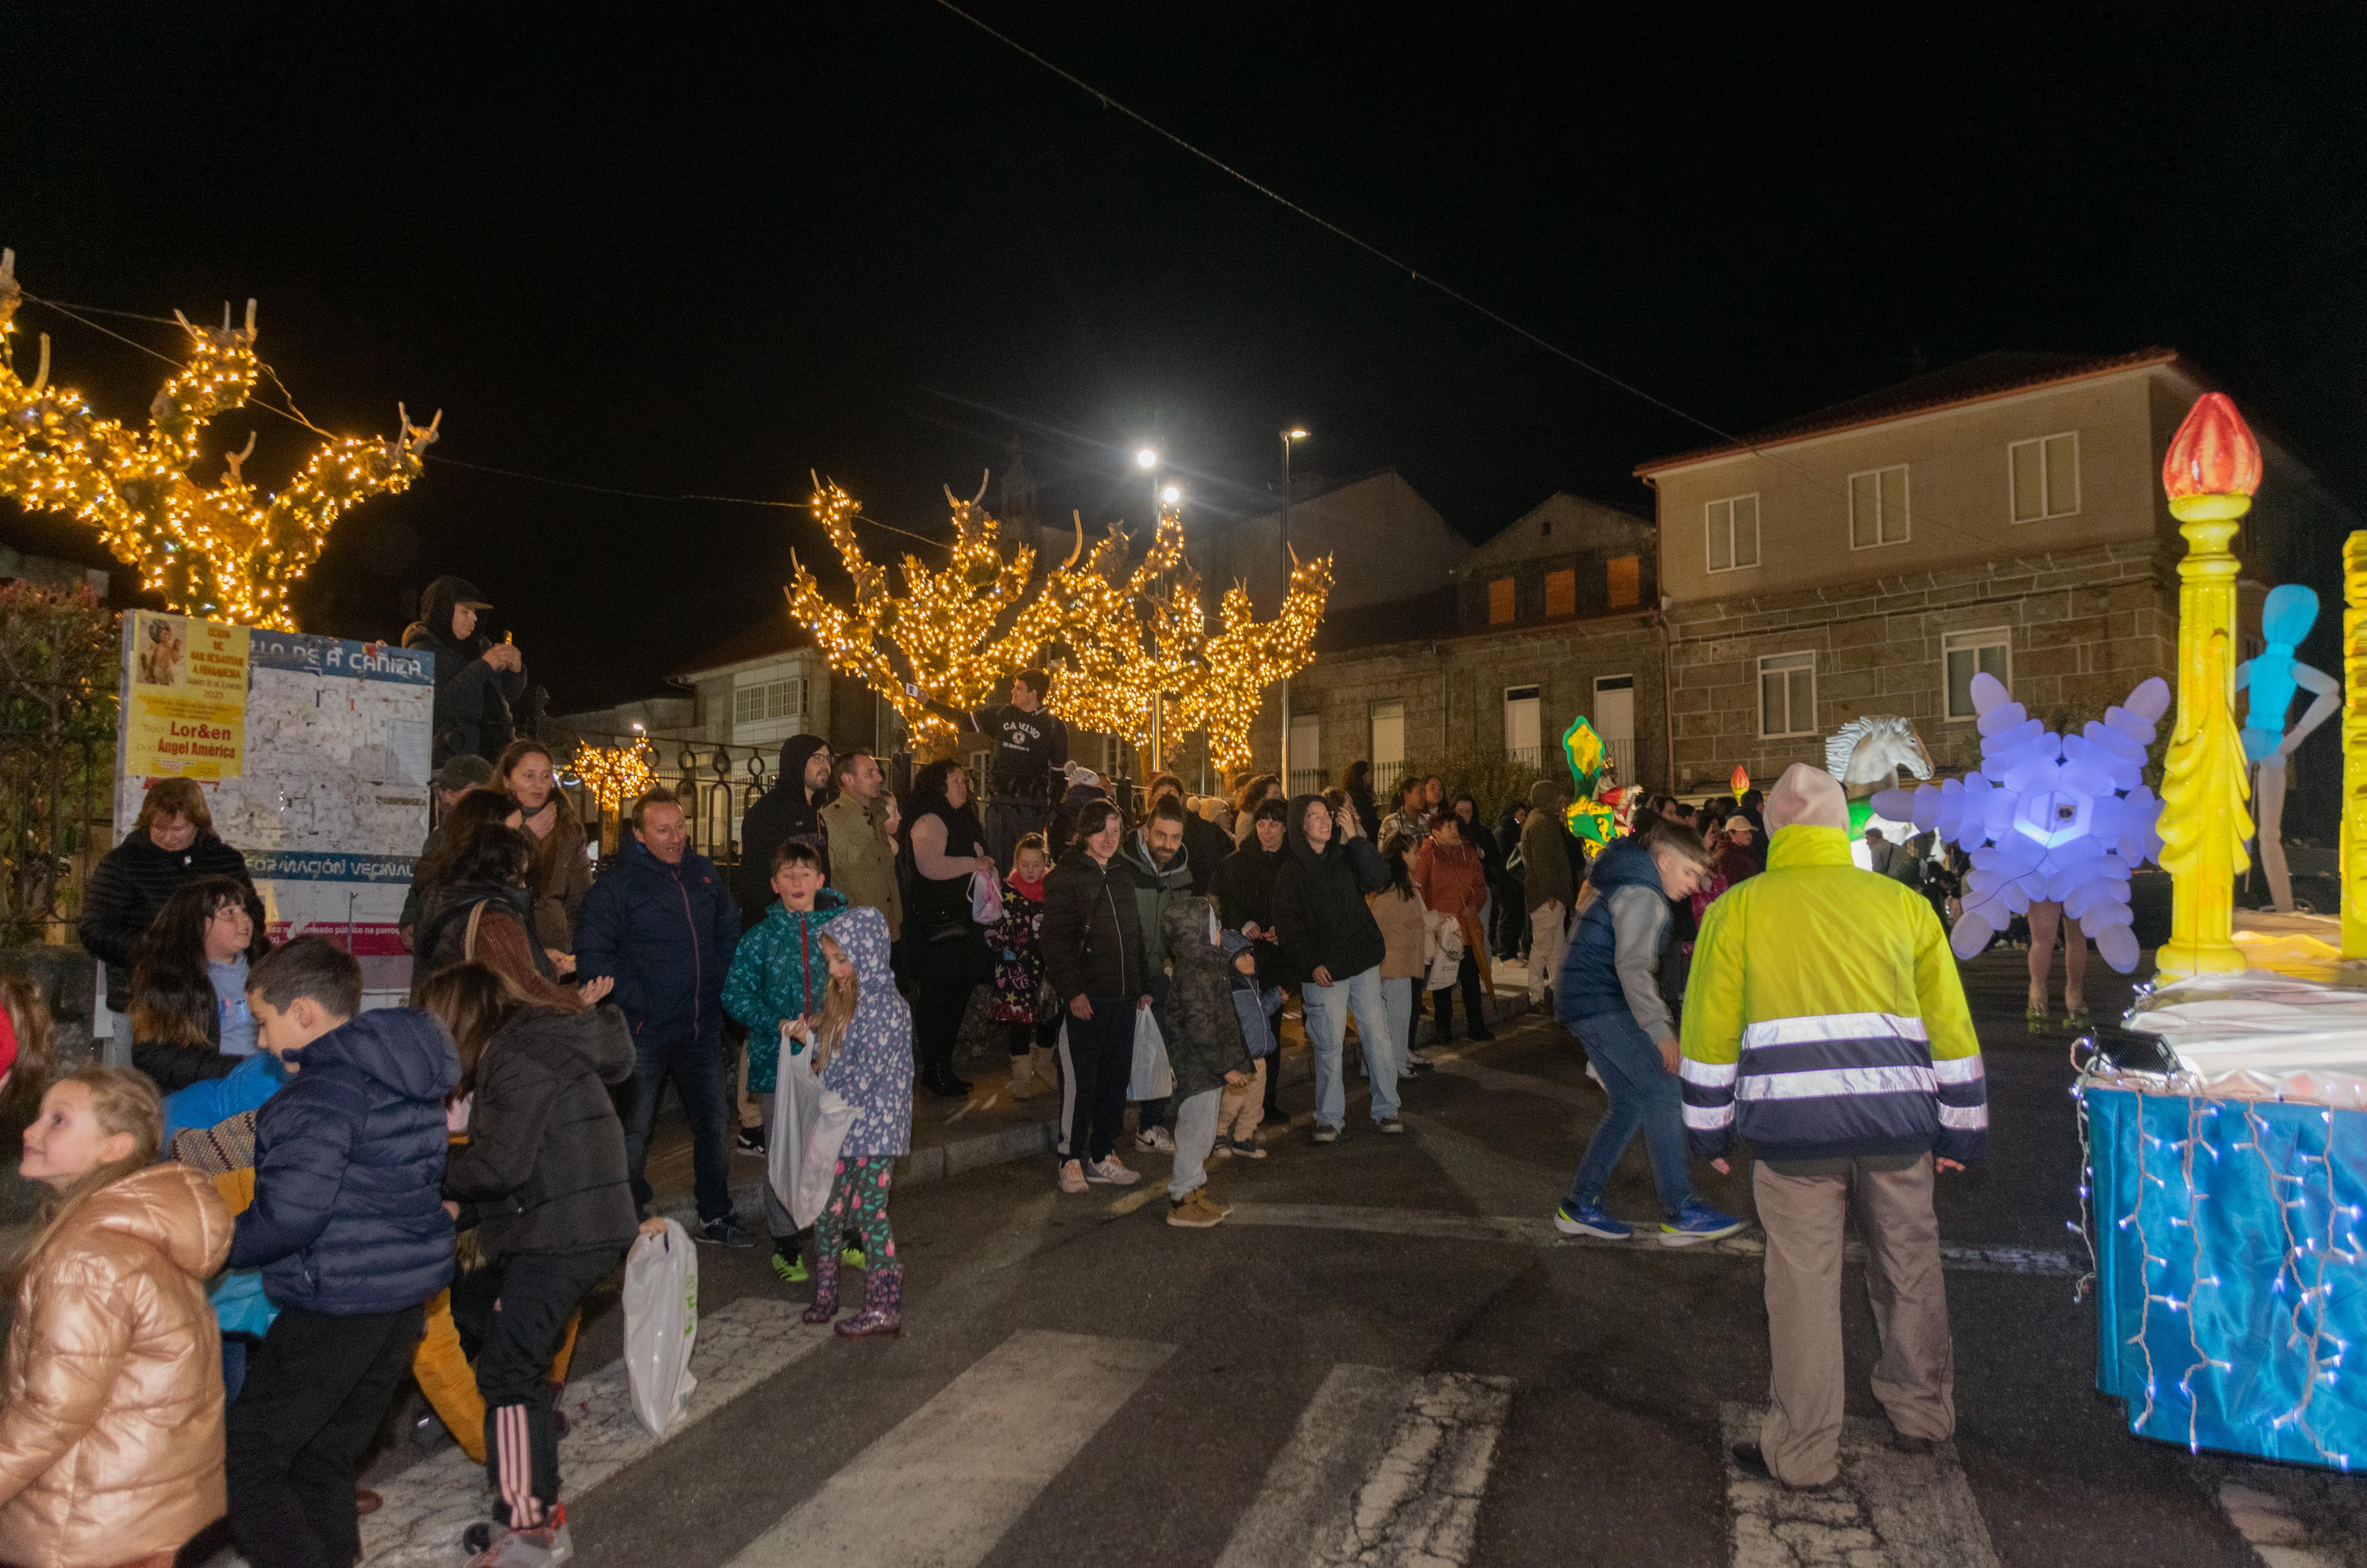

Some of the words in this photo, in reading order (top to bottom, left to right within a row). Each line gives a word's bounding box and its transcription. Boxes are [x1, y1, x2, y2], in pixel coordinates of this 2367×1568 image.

[326, 650, 340, 667] A
[170, 721, 231, 740] Lor&en
[191, 742, 236, 759] América
